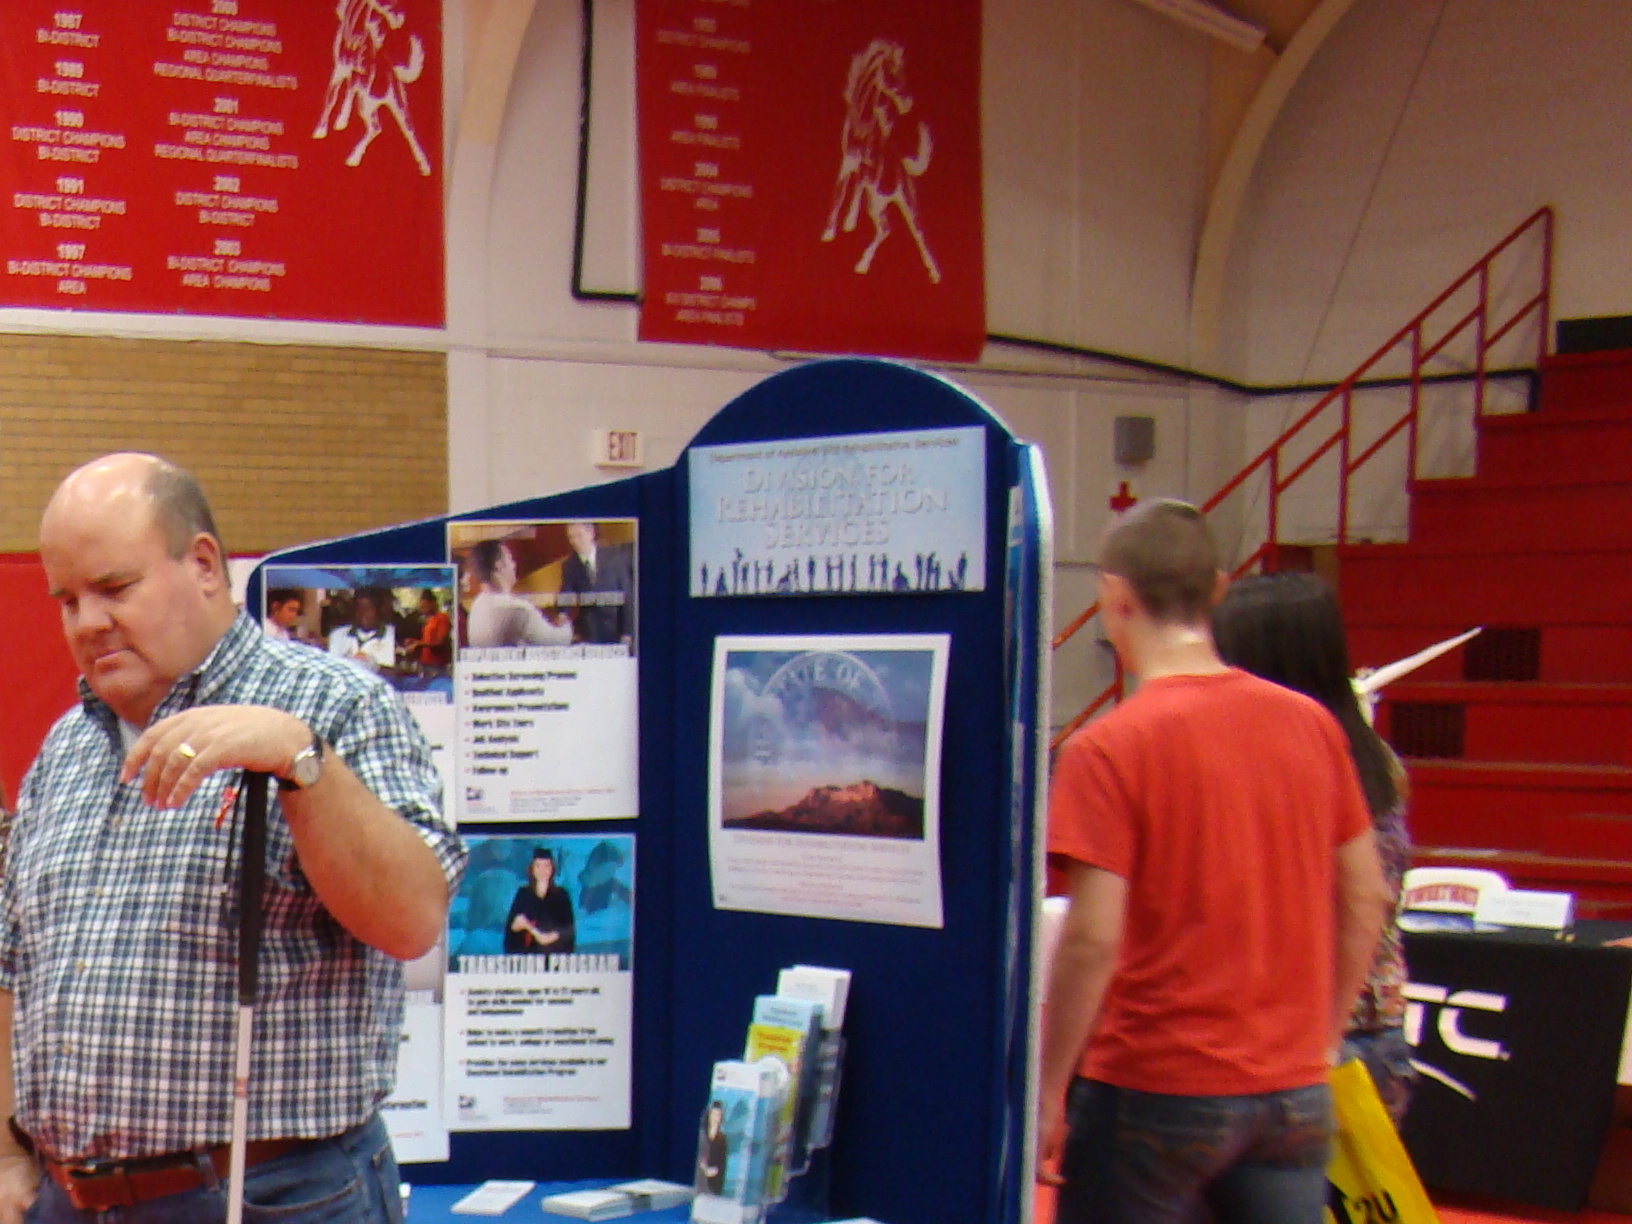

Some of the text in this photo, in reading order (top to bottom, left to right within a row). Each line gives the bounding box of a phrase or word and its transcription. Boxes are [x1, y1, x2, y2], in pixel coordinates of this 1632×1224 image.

[609, 431, 638, 461] EXIT
[744, 463, 917, 495] DIVISION FOR
[718, 488, 949, 524] REHABILITATION
[766, 519, 890, 549] SERVICES
